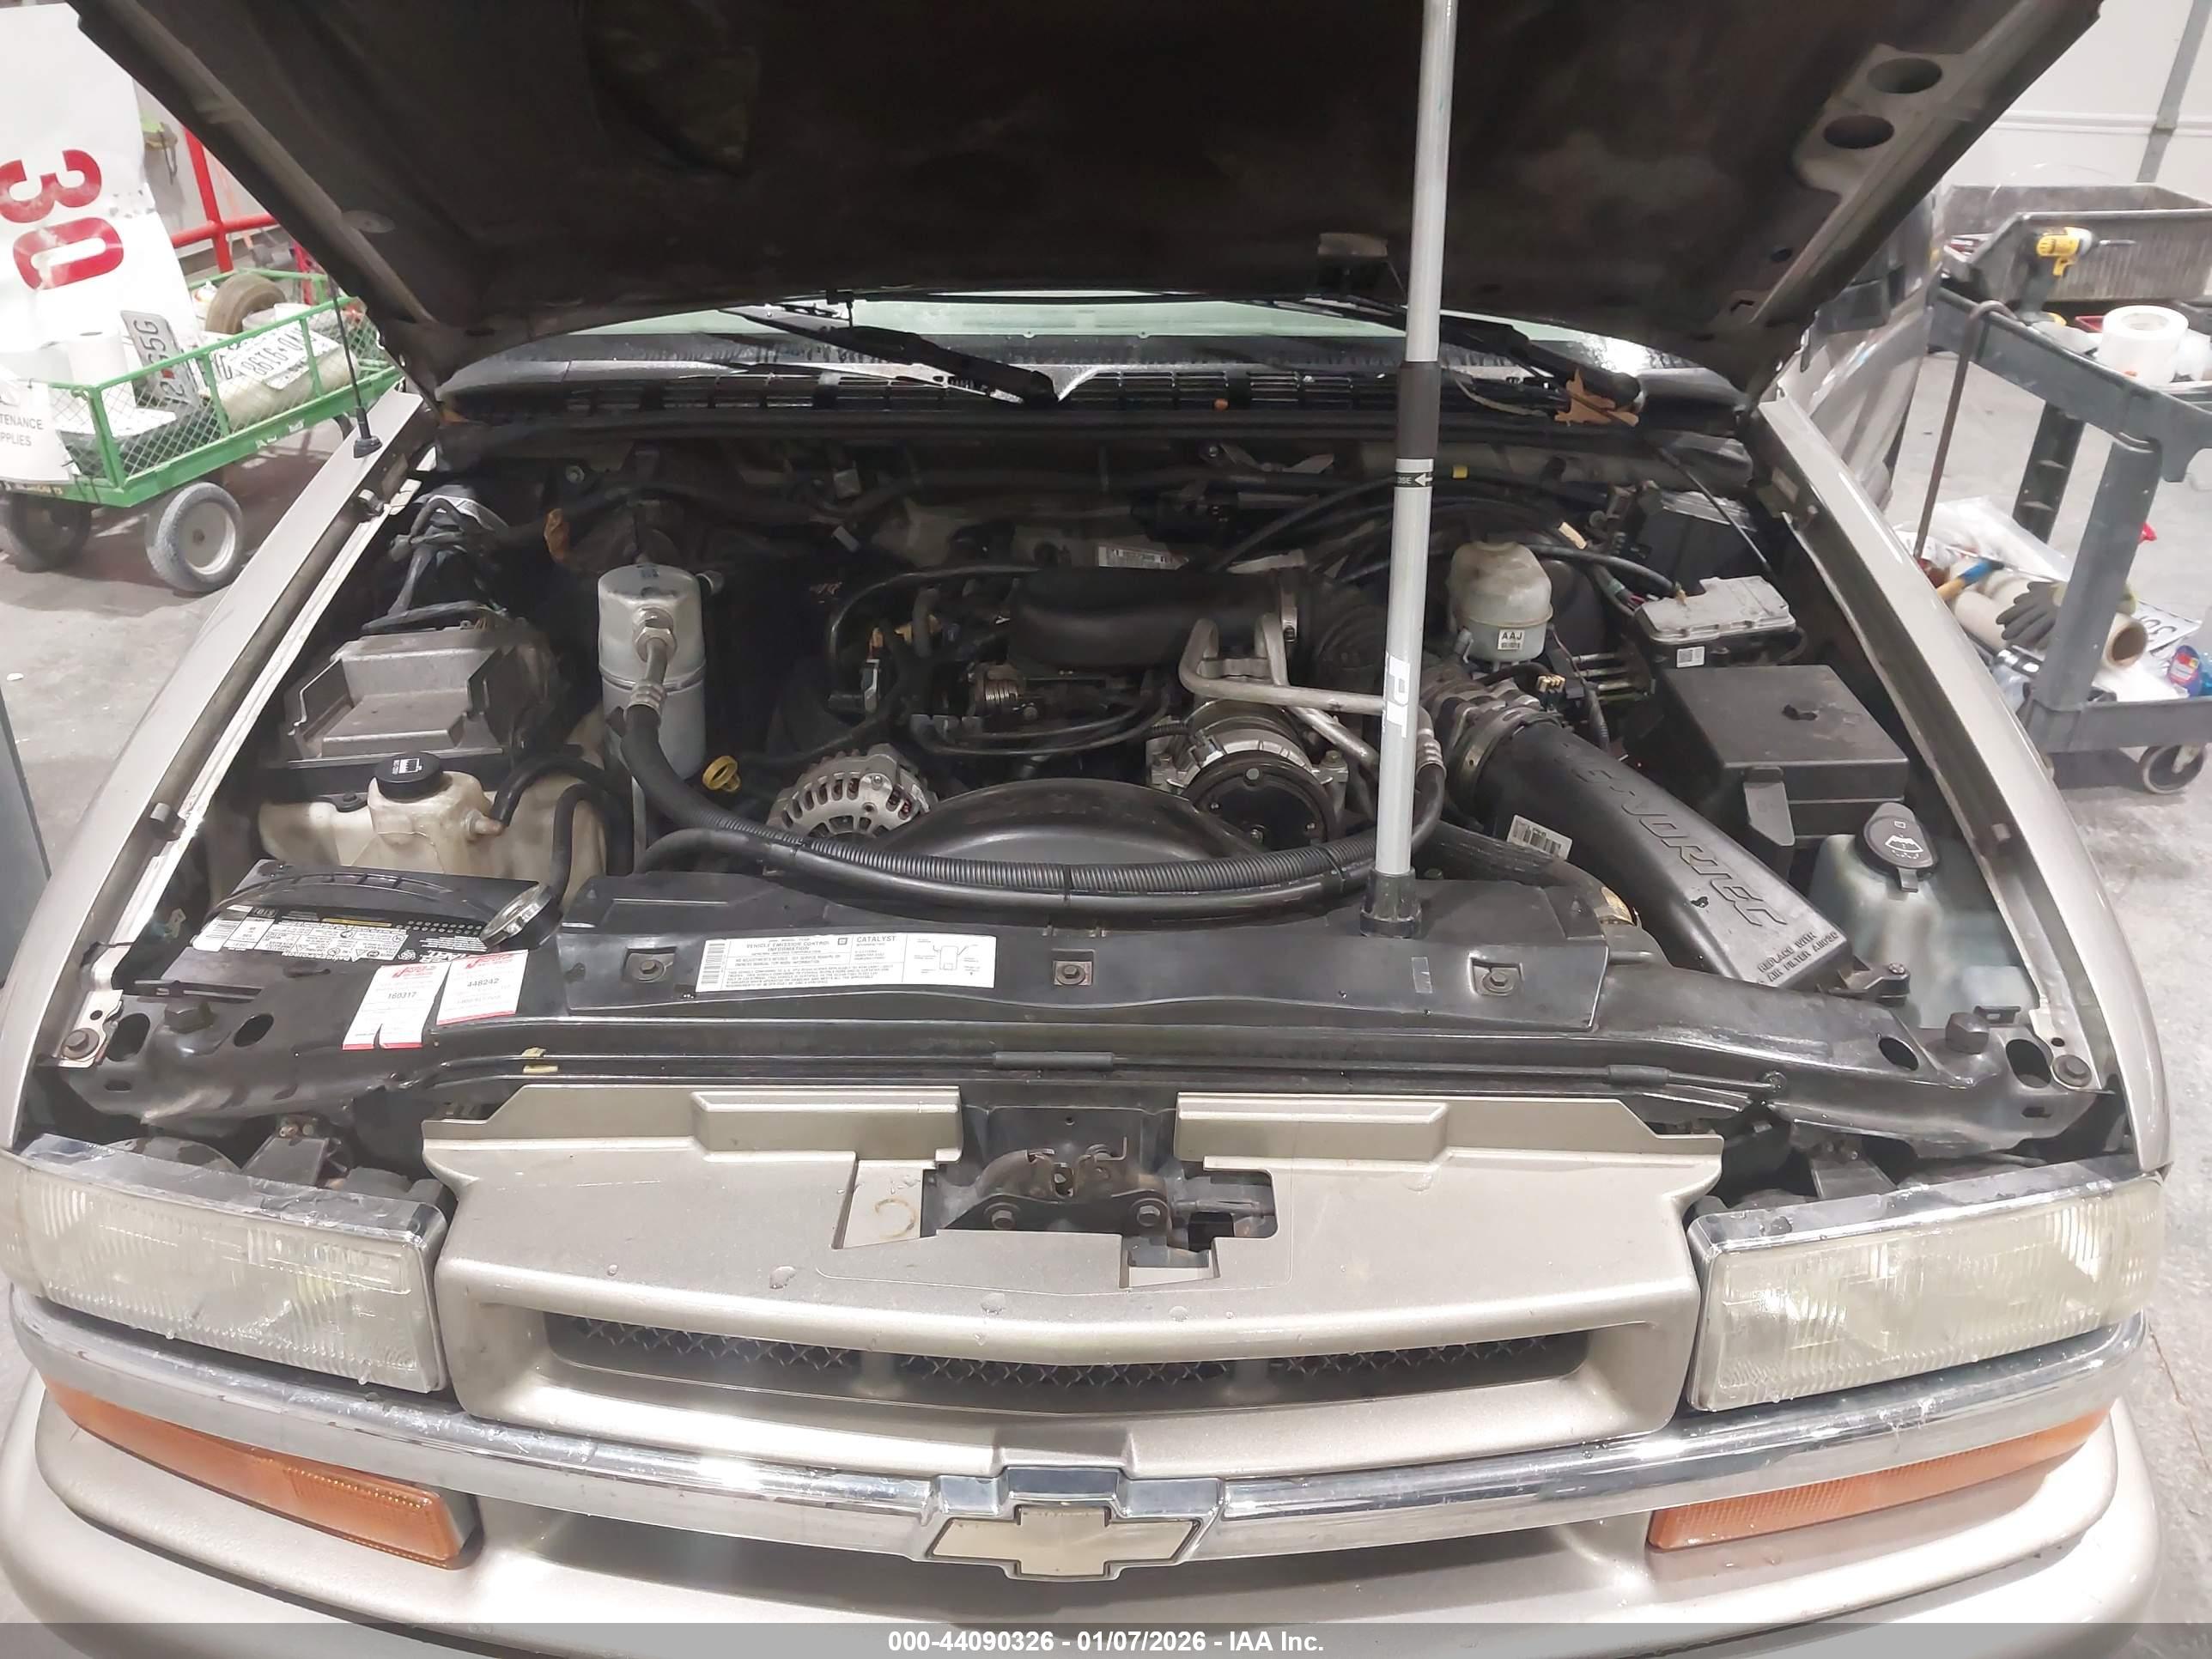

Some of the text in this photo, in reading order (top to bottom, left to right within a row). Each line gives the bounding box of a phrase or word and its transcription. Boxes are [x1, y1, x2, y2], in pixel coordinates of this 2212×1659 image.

[0, 149, 124, 289] 30
[1502, 631, 1522, 641] AAJ
[387, 991, 417, 1000] 160317
